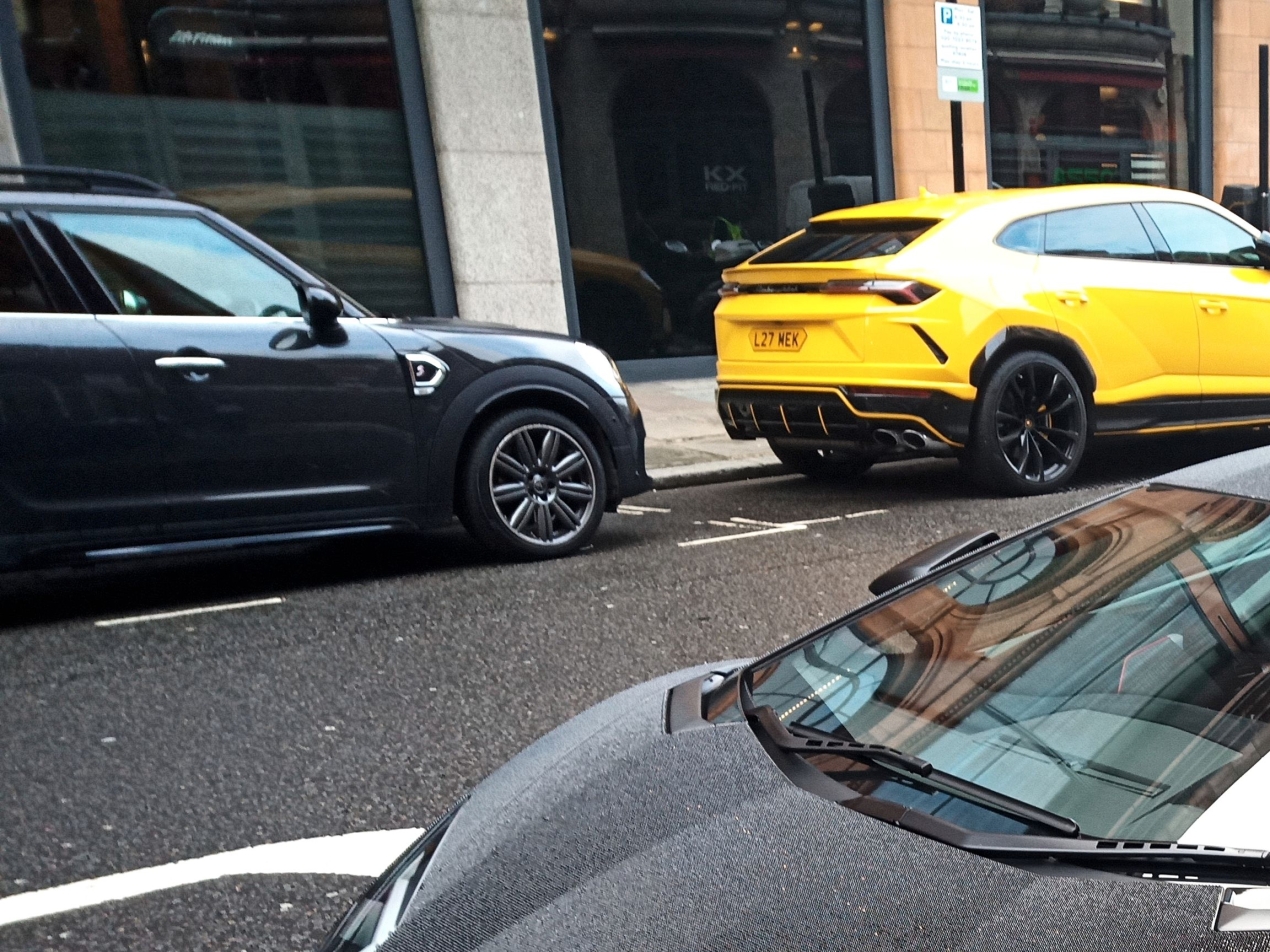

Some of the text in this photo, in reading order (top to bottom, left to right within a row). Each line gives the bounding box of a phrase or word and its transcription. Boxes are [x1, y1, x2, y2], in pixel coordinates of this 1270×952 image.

[703, 165, 747, 182] KX
[754, 331, 799, 347] L27 MEK
